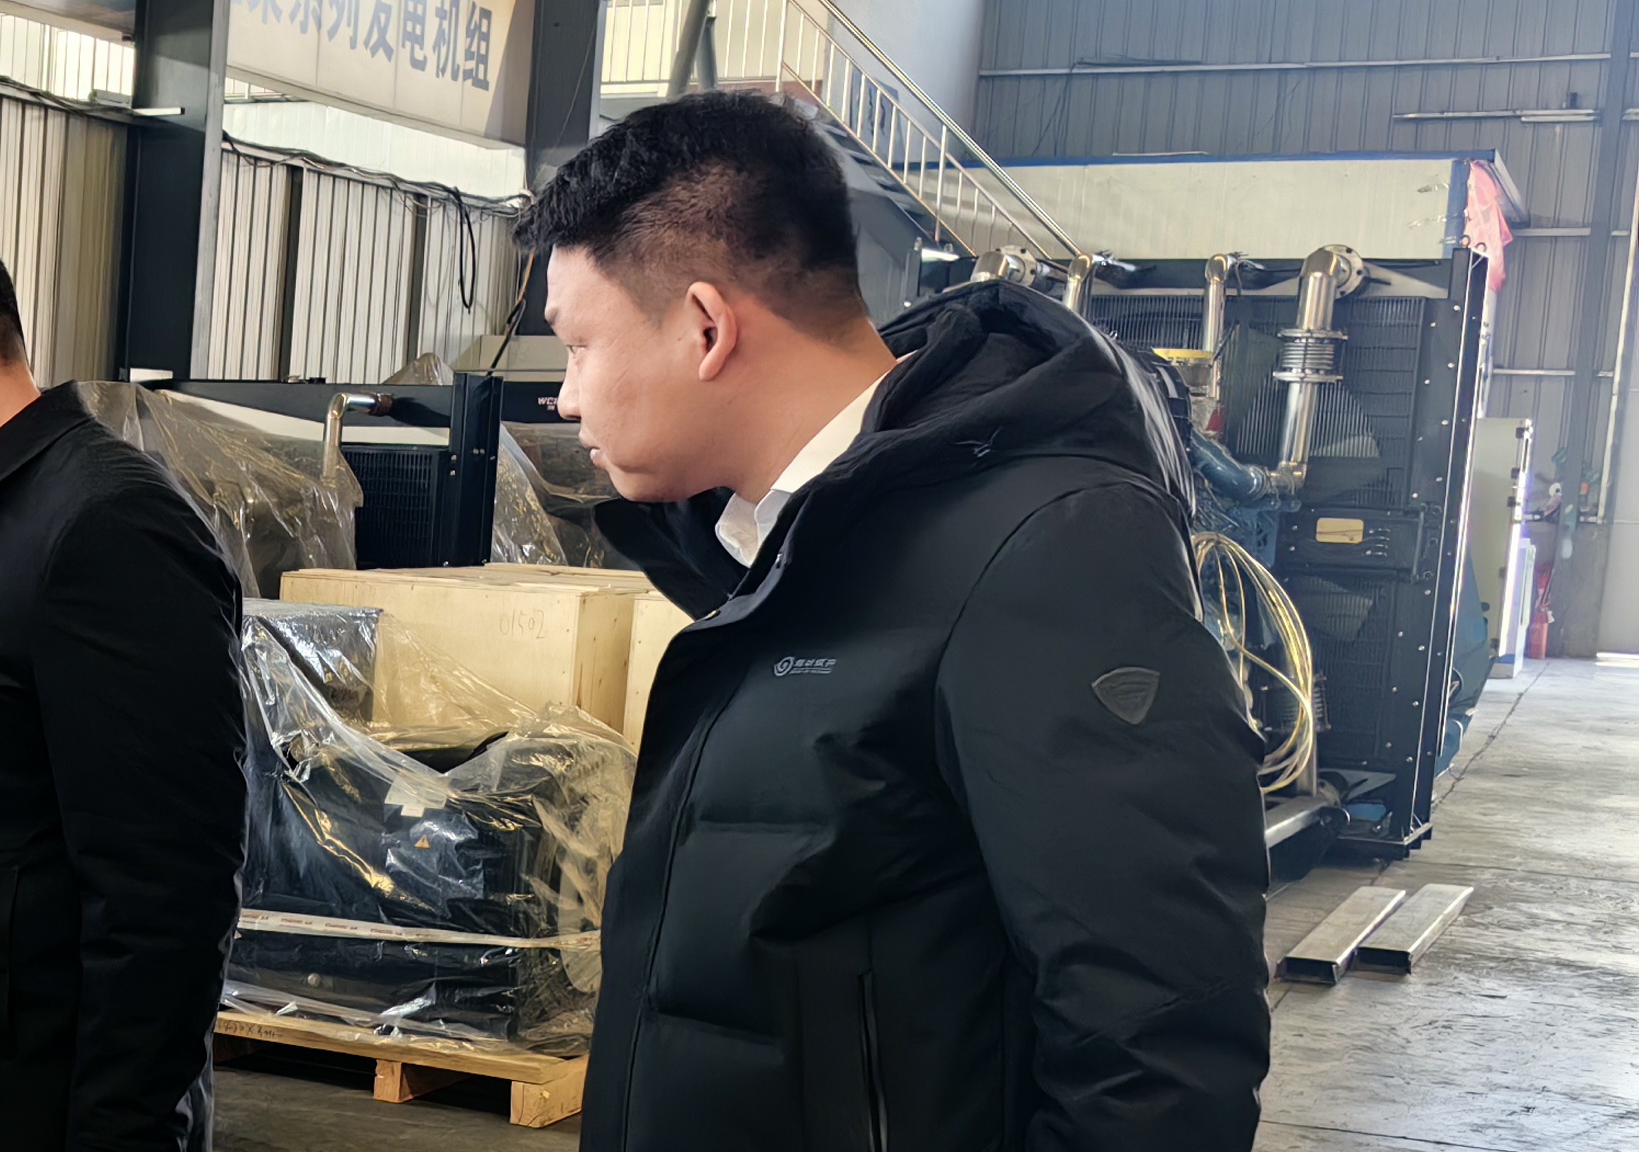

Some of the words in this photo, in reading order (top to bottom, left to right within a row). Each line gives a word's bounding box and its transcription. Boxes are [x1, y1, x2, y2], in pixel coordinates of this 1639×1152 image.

[231, 0, 492, 91] 列发电机组
